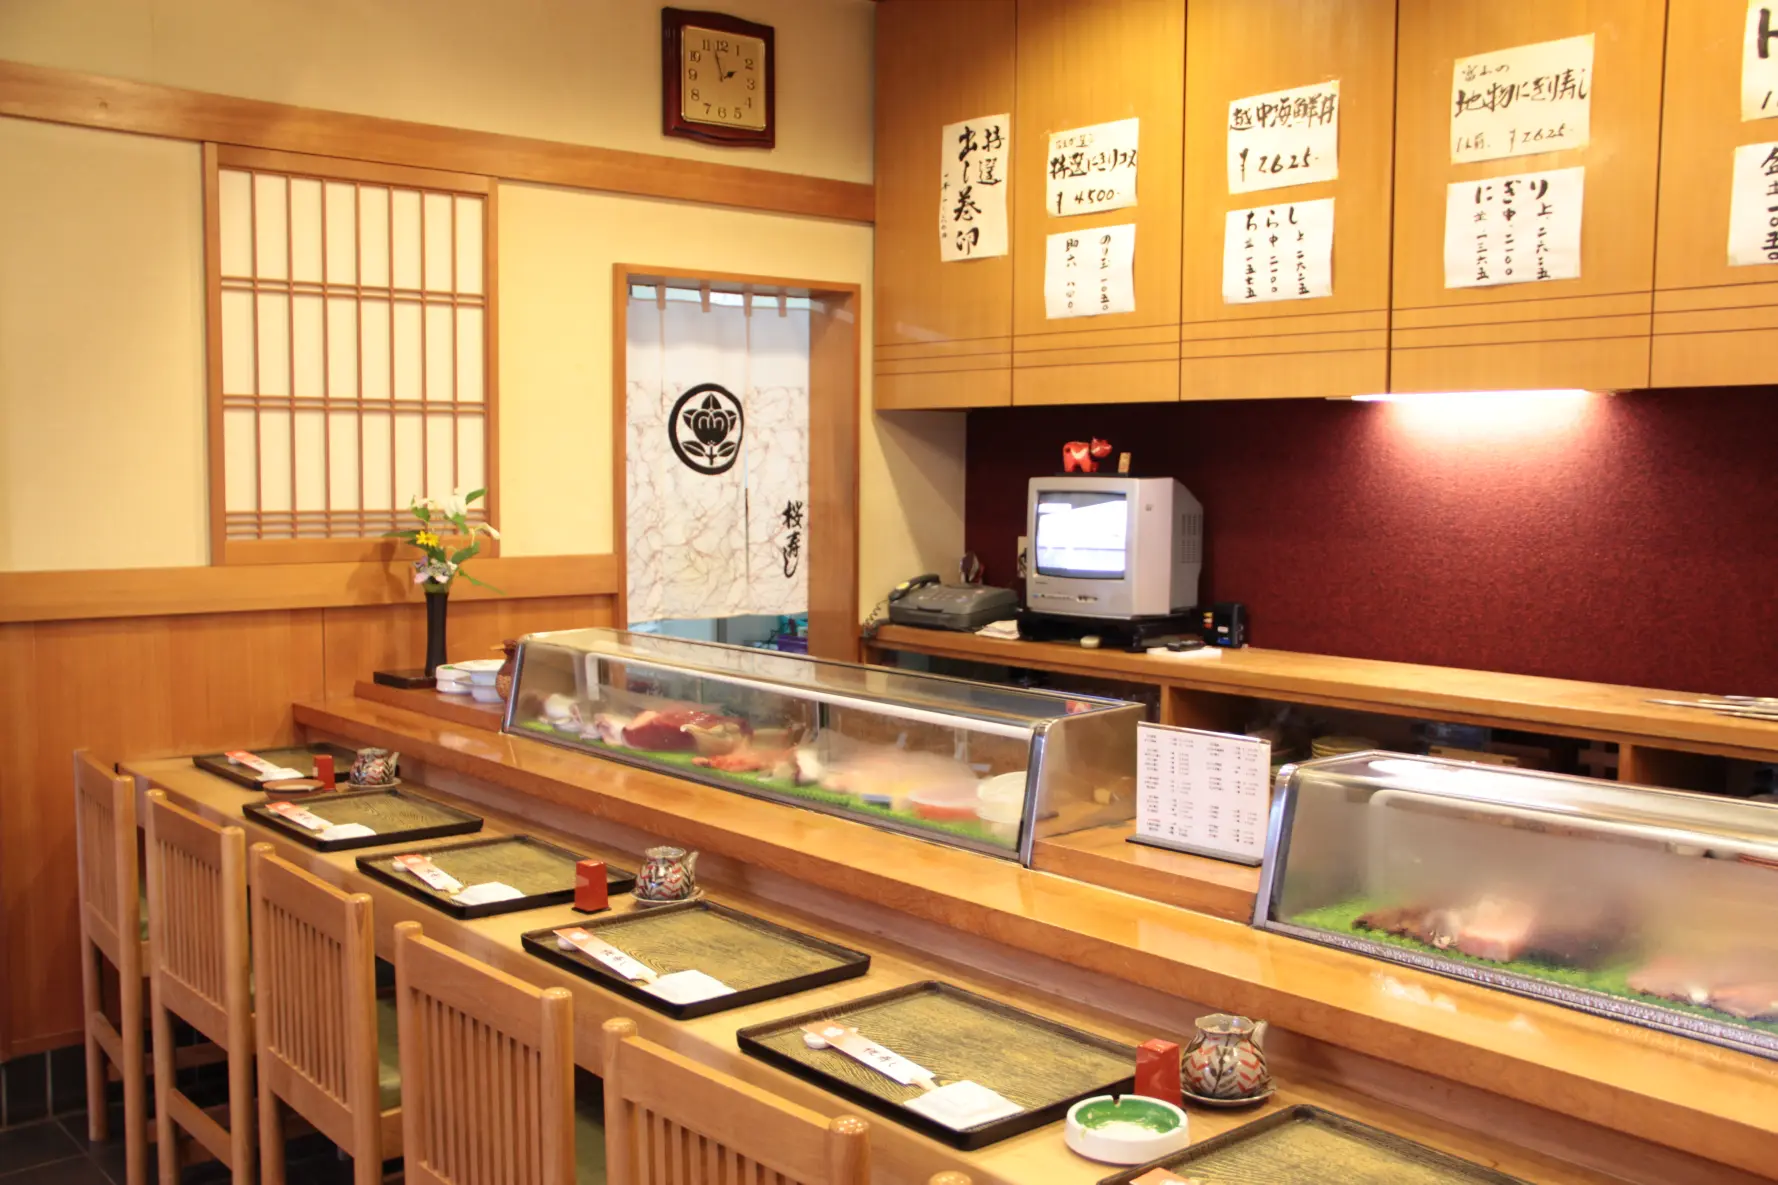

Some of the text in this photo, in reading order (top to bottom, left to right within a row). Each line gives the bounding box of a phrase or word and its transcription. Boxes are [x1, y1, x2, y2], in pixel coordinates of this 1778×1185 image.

[702, 39, 711, 52] 11
[715, 39, 729, 53] 12
[735, 44, 740, 57] 1
[689, 50, 701, 64] 10
[744, 58, 754, 71] 2
[688, 68, 698, 81] 9
[746, 78, 755, 91] 3
[690, 88, 700, 102] 8
[703, 102, 712, 115] 7
[744, 97, 752, 109] 4
[717, 107, 727, 119] 6
[733, 107, 742, 120] 5
[1229, 92, 1337, 131] 越中海鮮丼
